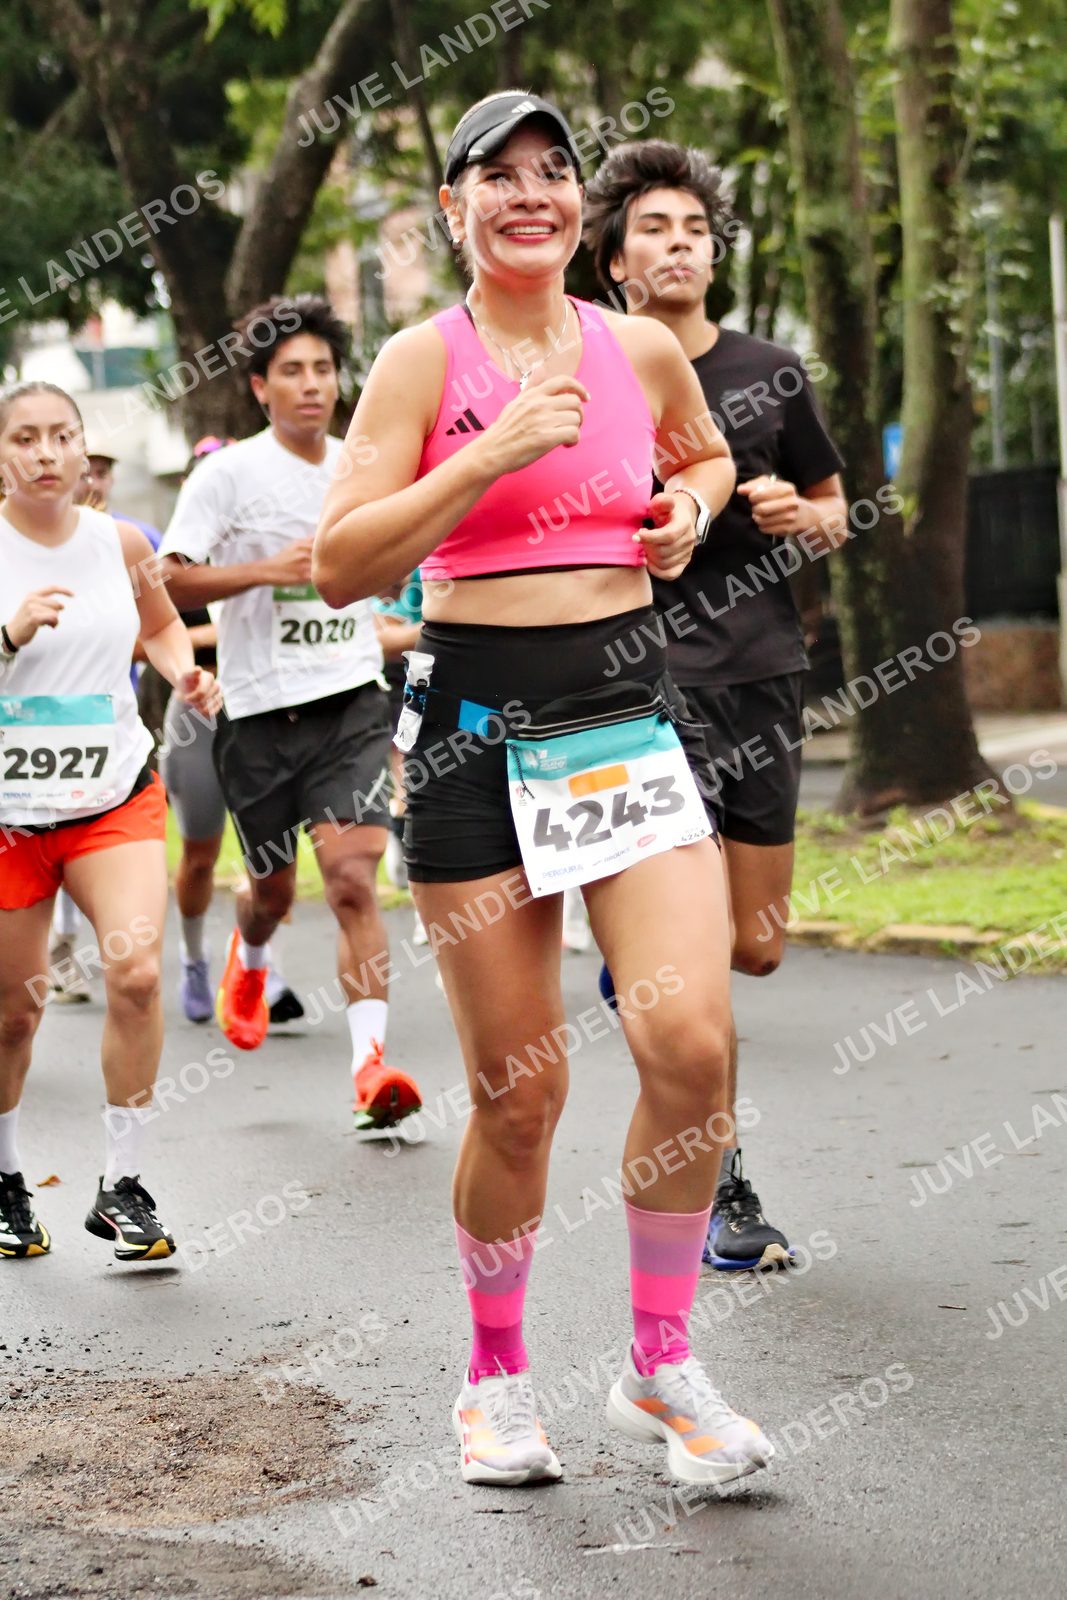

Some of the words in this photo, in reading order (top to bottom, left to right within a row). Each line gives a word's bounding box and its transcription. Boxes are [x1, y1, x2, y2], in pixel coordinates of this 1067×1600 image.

[280, 617, 356, 645] 2020
[3, 746, 109, 780] 2927
[532, 775, 686, 853] 4243
